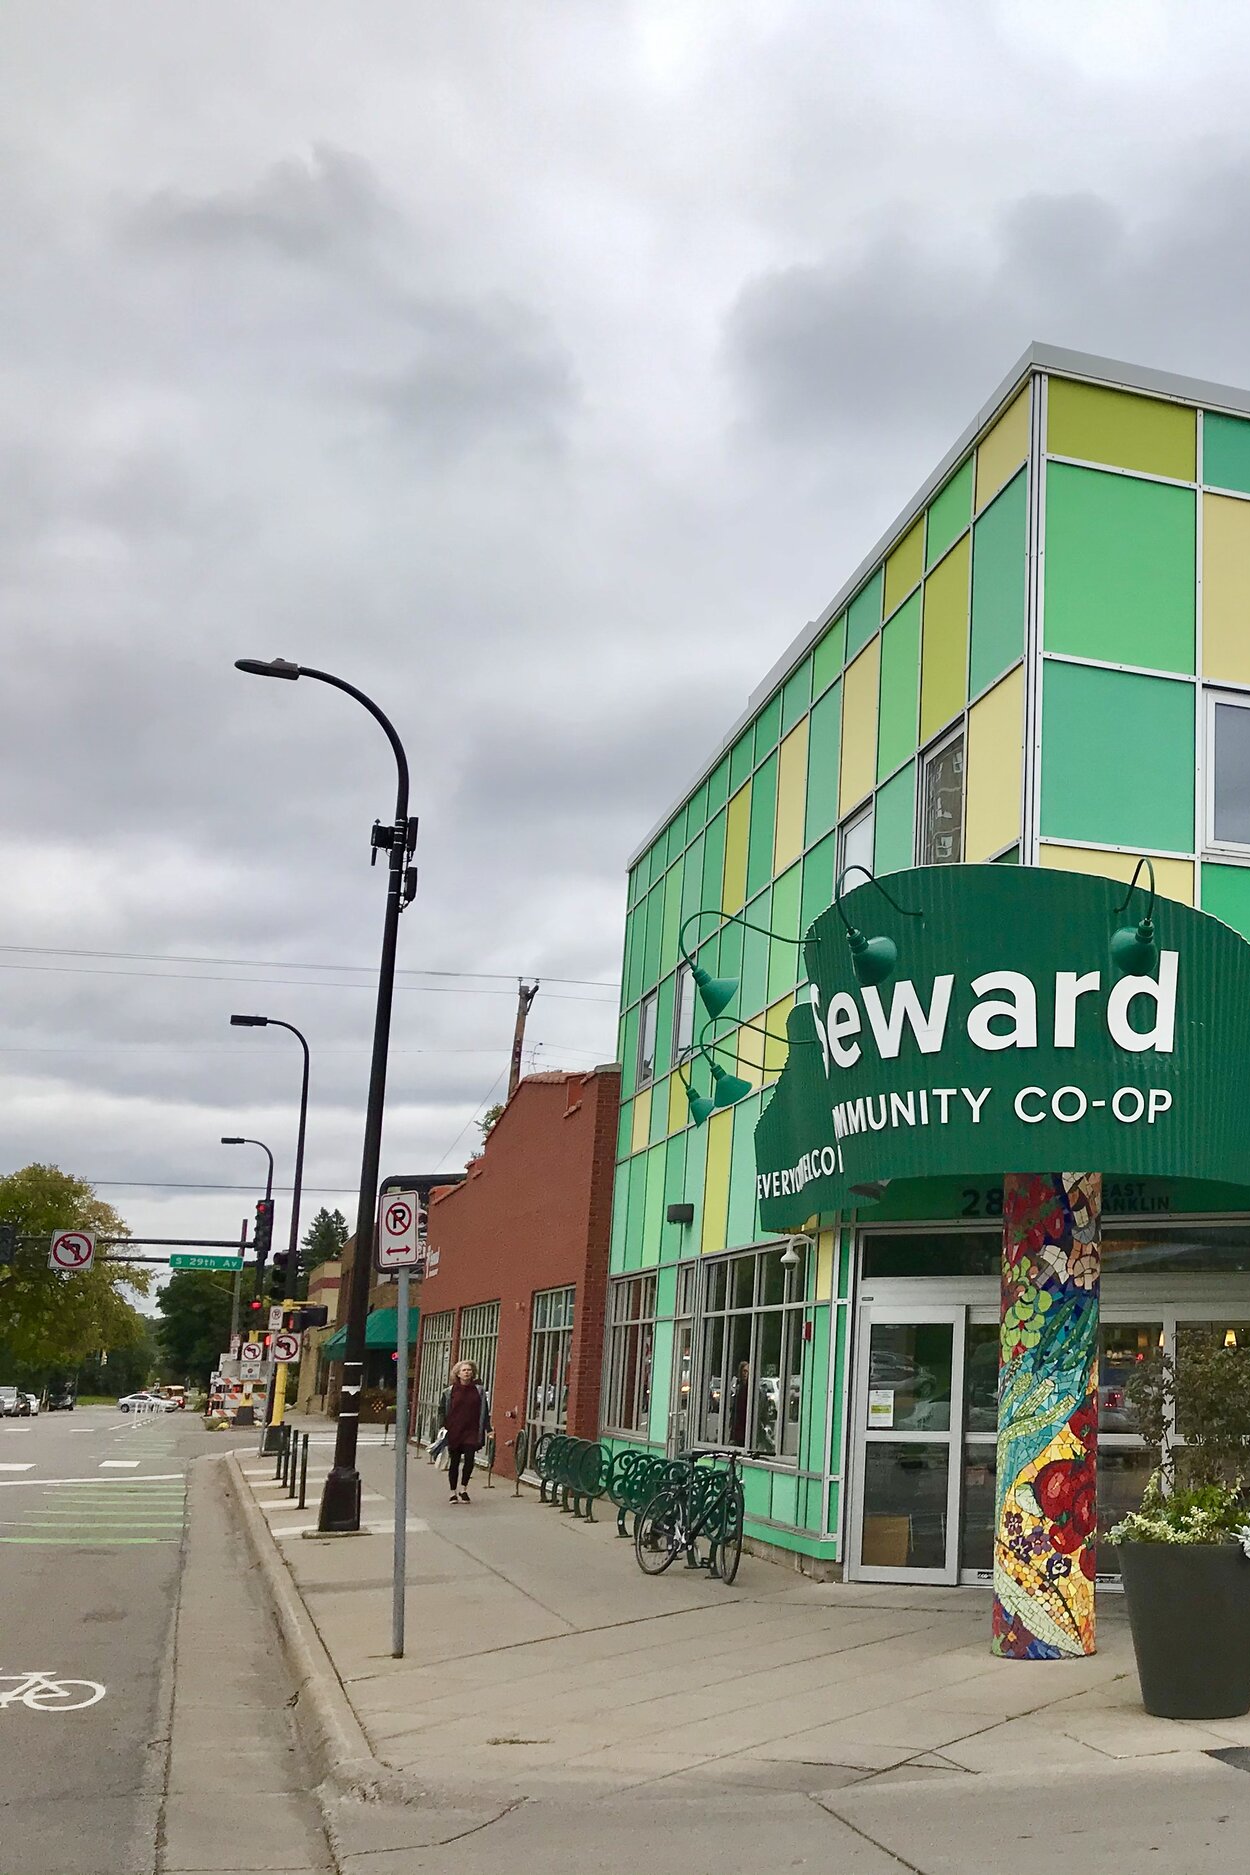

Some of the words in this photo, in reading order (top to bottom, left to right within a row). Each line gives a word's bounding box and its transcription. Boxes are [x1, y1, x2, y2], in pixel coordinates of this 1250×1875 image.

[832, 1087, 992, 1142] MMUNITY
[1014, 1085, 1173, 1124] CO-OP
[961, 1188, 1005, 1217] 28
[1102, 1196, 1169, 1212] ANKLIN
[175, 1256, 182, 1265] S
[189, 1257, 216, 1266] 29th
[222, 1259, 238, 1267] Av
